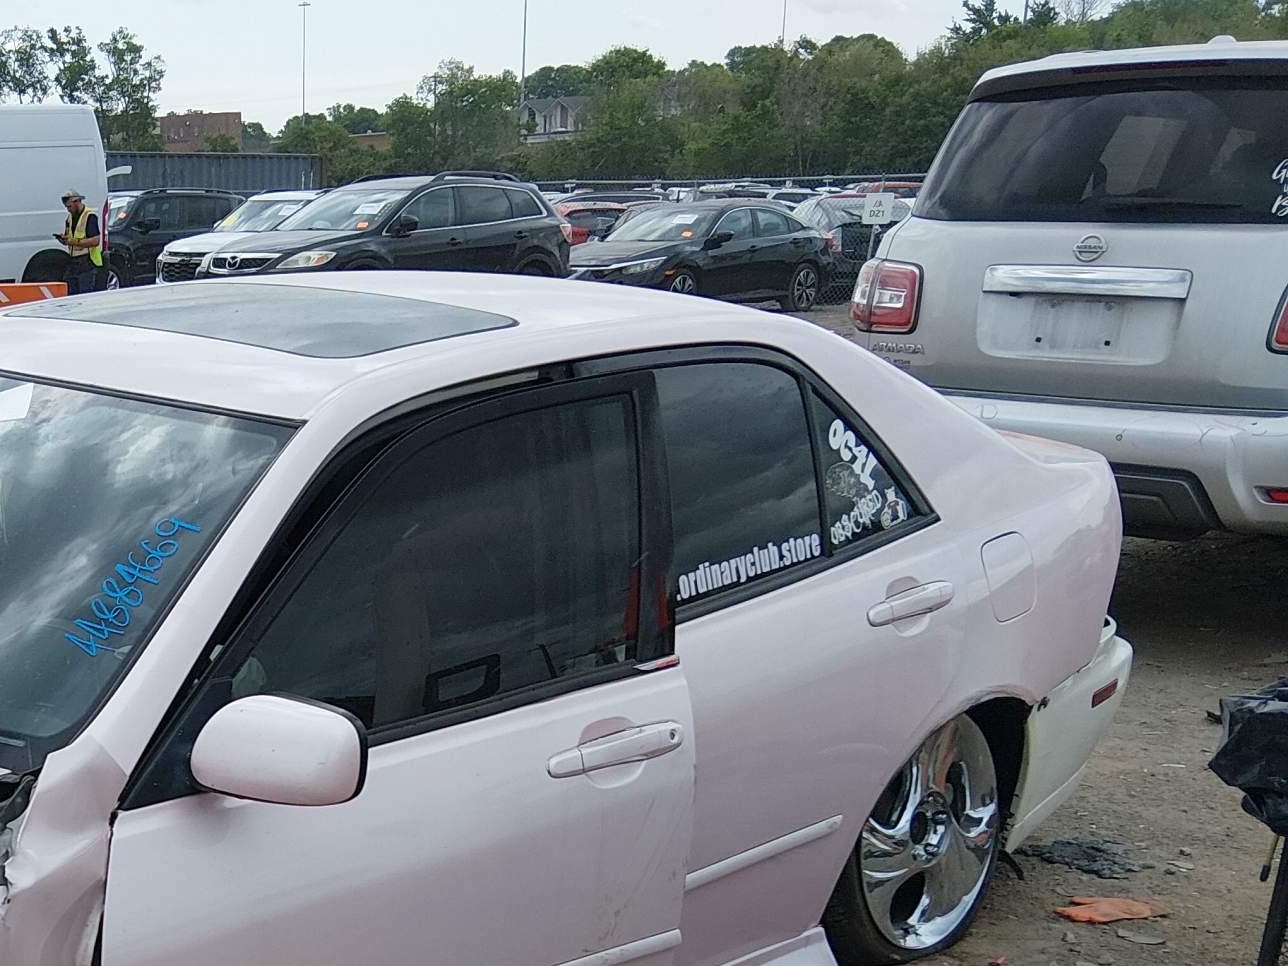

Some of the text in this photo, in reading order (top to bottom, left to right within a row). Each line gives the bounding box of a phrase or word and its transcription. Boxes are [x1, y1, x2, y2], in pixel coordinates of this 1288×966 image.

[1075, 243, 1104, 251] NISSAN
[872, 342, 926, 355] ARMADA
[830, 489, 882, 545] OBSCURED
[65, 517, 201, 657] 44884669
[676, 533, 822, 601] .ordinaryclub.store
